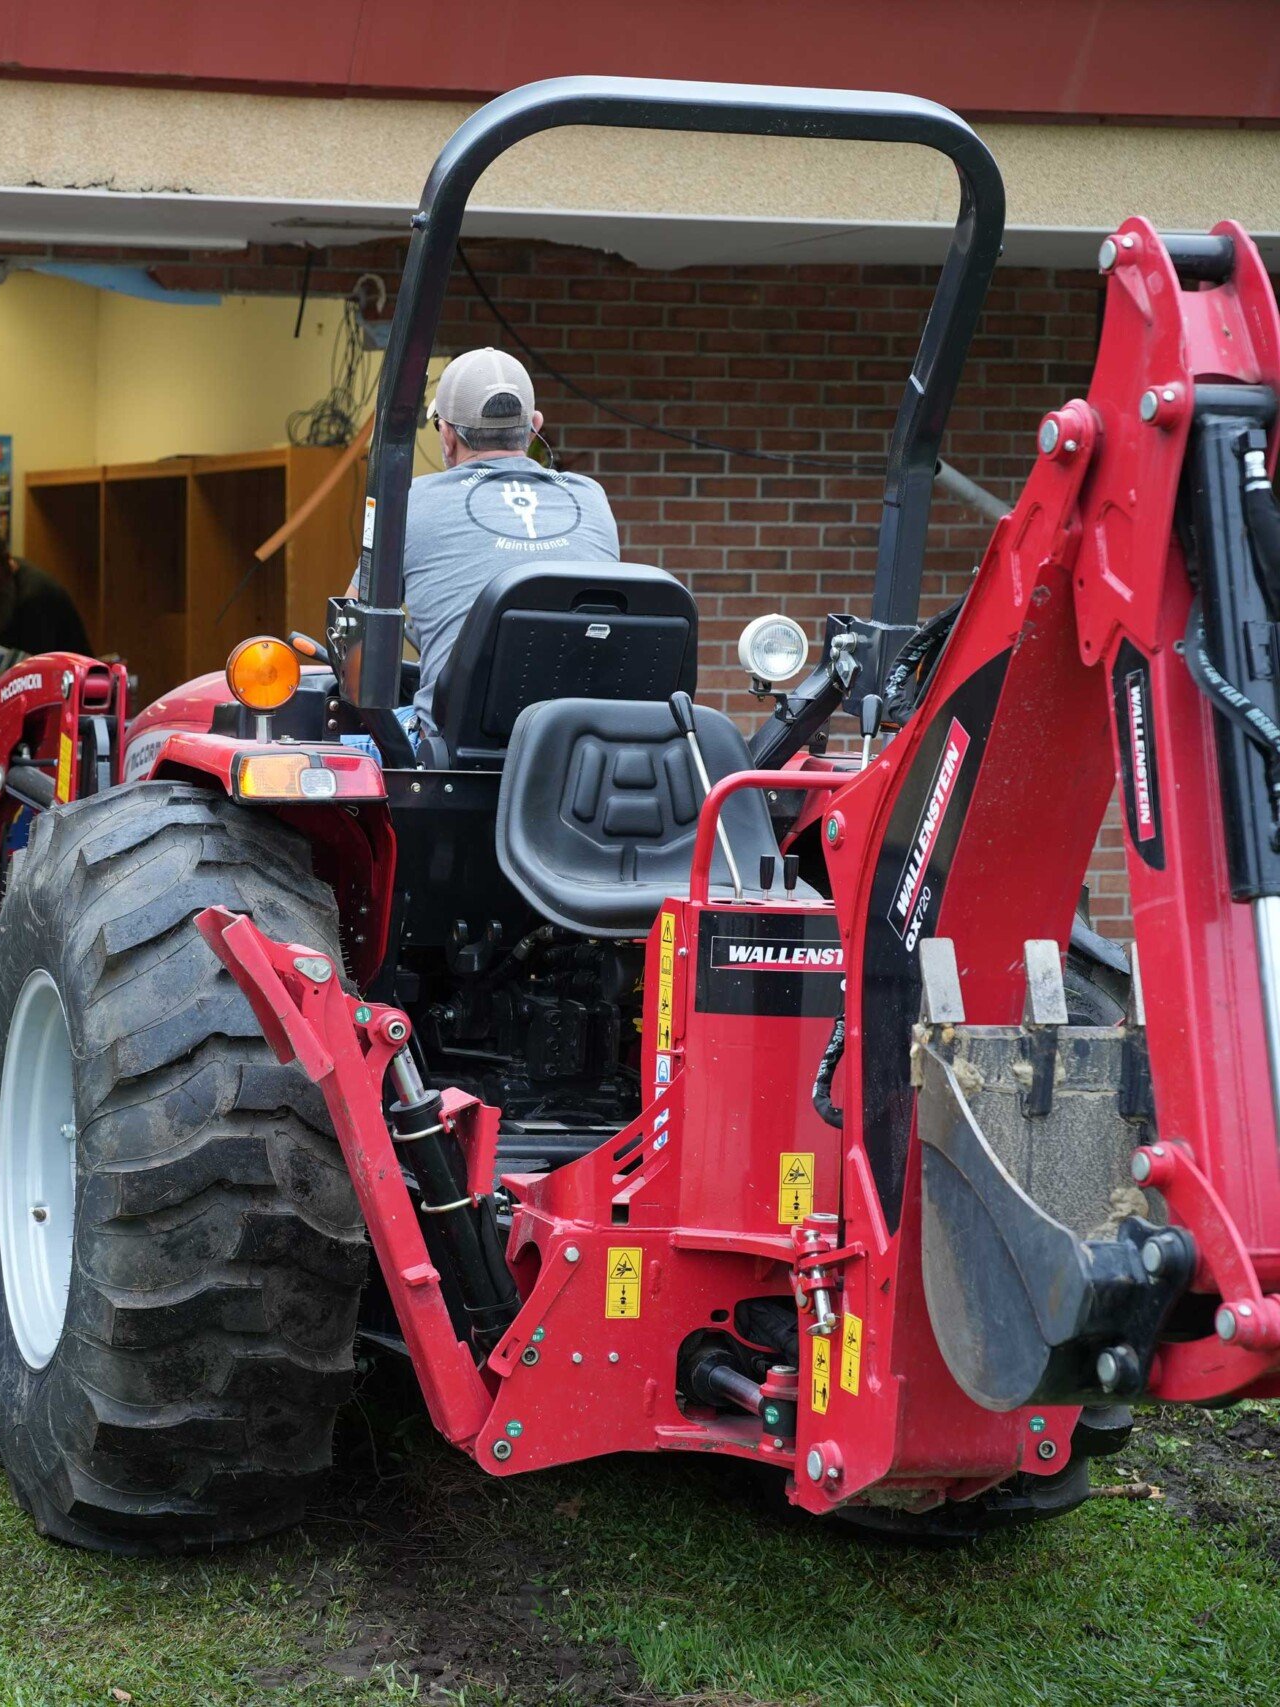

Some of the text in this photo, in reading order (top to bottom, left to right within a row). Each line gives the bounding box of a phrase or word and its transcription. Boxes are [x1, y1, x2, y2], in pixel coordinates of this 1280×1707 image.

[495, 537, 570, 551] Maintenance
[1130, 685, 1151, 824] WALLENSTEIN
[896, 741, 960, 917] WALLENSTEIN
[905, 886, 932, 952] GX720
